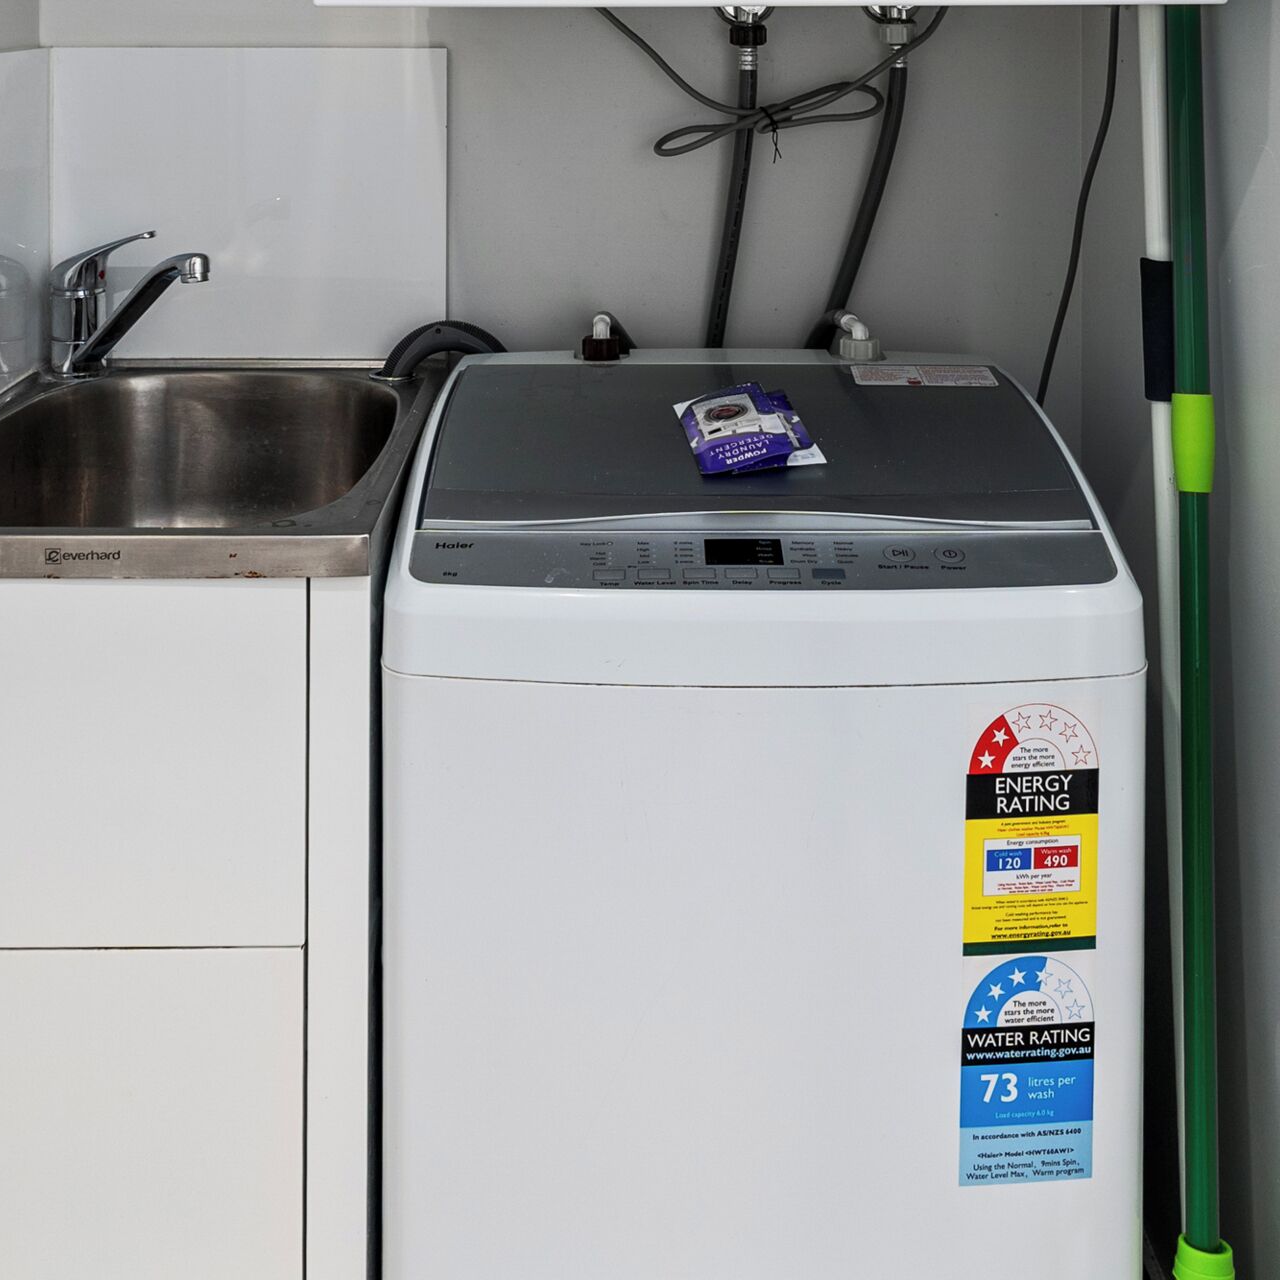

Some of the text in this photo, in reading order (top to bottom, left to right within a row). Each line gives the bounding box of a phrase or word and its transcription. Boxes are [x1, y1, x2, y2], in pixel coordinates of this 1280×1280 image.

[709, 434, 773, 456] DETERGENT
[718, 439, 769, 459] LAUNDRY
[725, 448, 767, 465] POWDER
[62, 550, 121, 560] everhard
[995, 774, 1073, 795] ENERGY
[997, 794, 1070, 814] RATING
[998, 857, 1021, 870] 120
[1044, 854, 1068, 867] 490
[991, 930, 1071, 939] www.energyrating.gov.au
[1026, 1015, 1054, 1023] efficient
[967, 1028, 1090, 1048] WATER RATING
[966, 1046, 1091, 1060] www.waterrating.gov.au
[980, 1073, 1018, 1103] 73
[1028, 1076, 1076, 1088] litres per
[1028, 1088, 1055, 1099] wash
[1011, 1111, 1035, 1119] capacity
[1037, 1129, 1064, 1137] AS/NZS
[973, 1163, 992, 1171] Using
[1055, 1167, 1084, 1176] program
